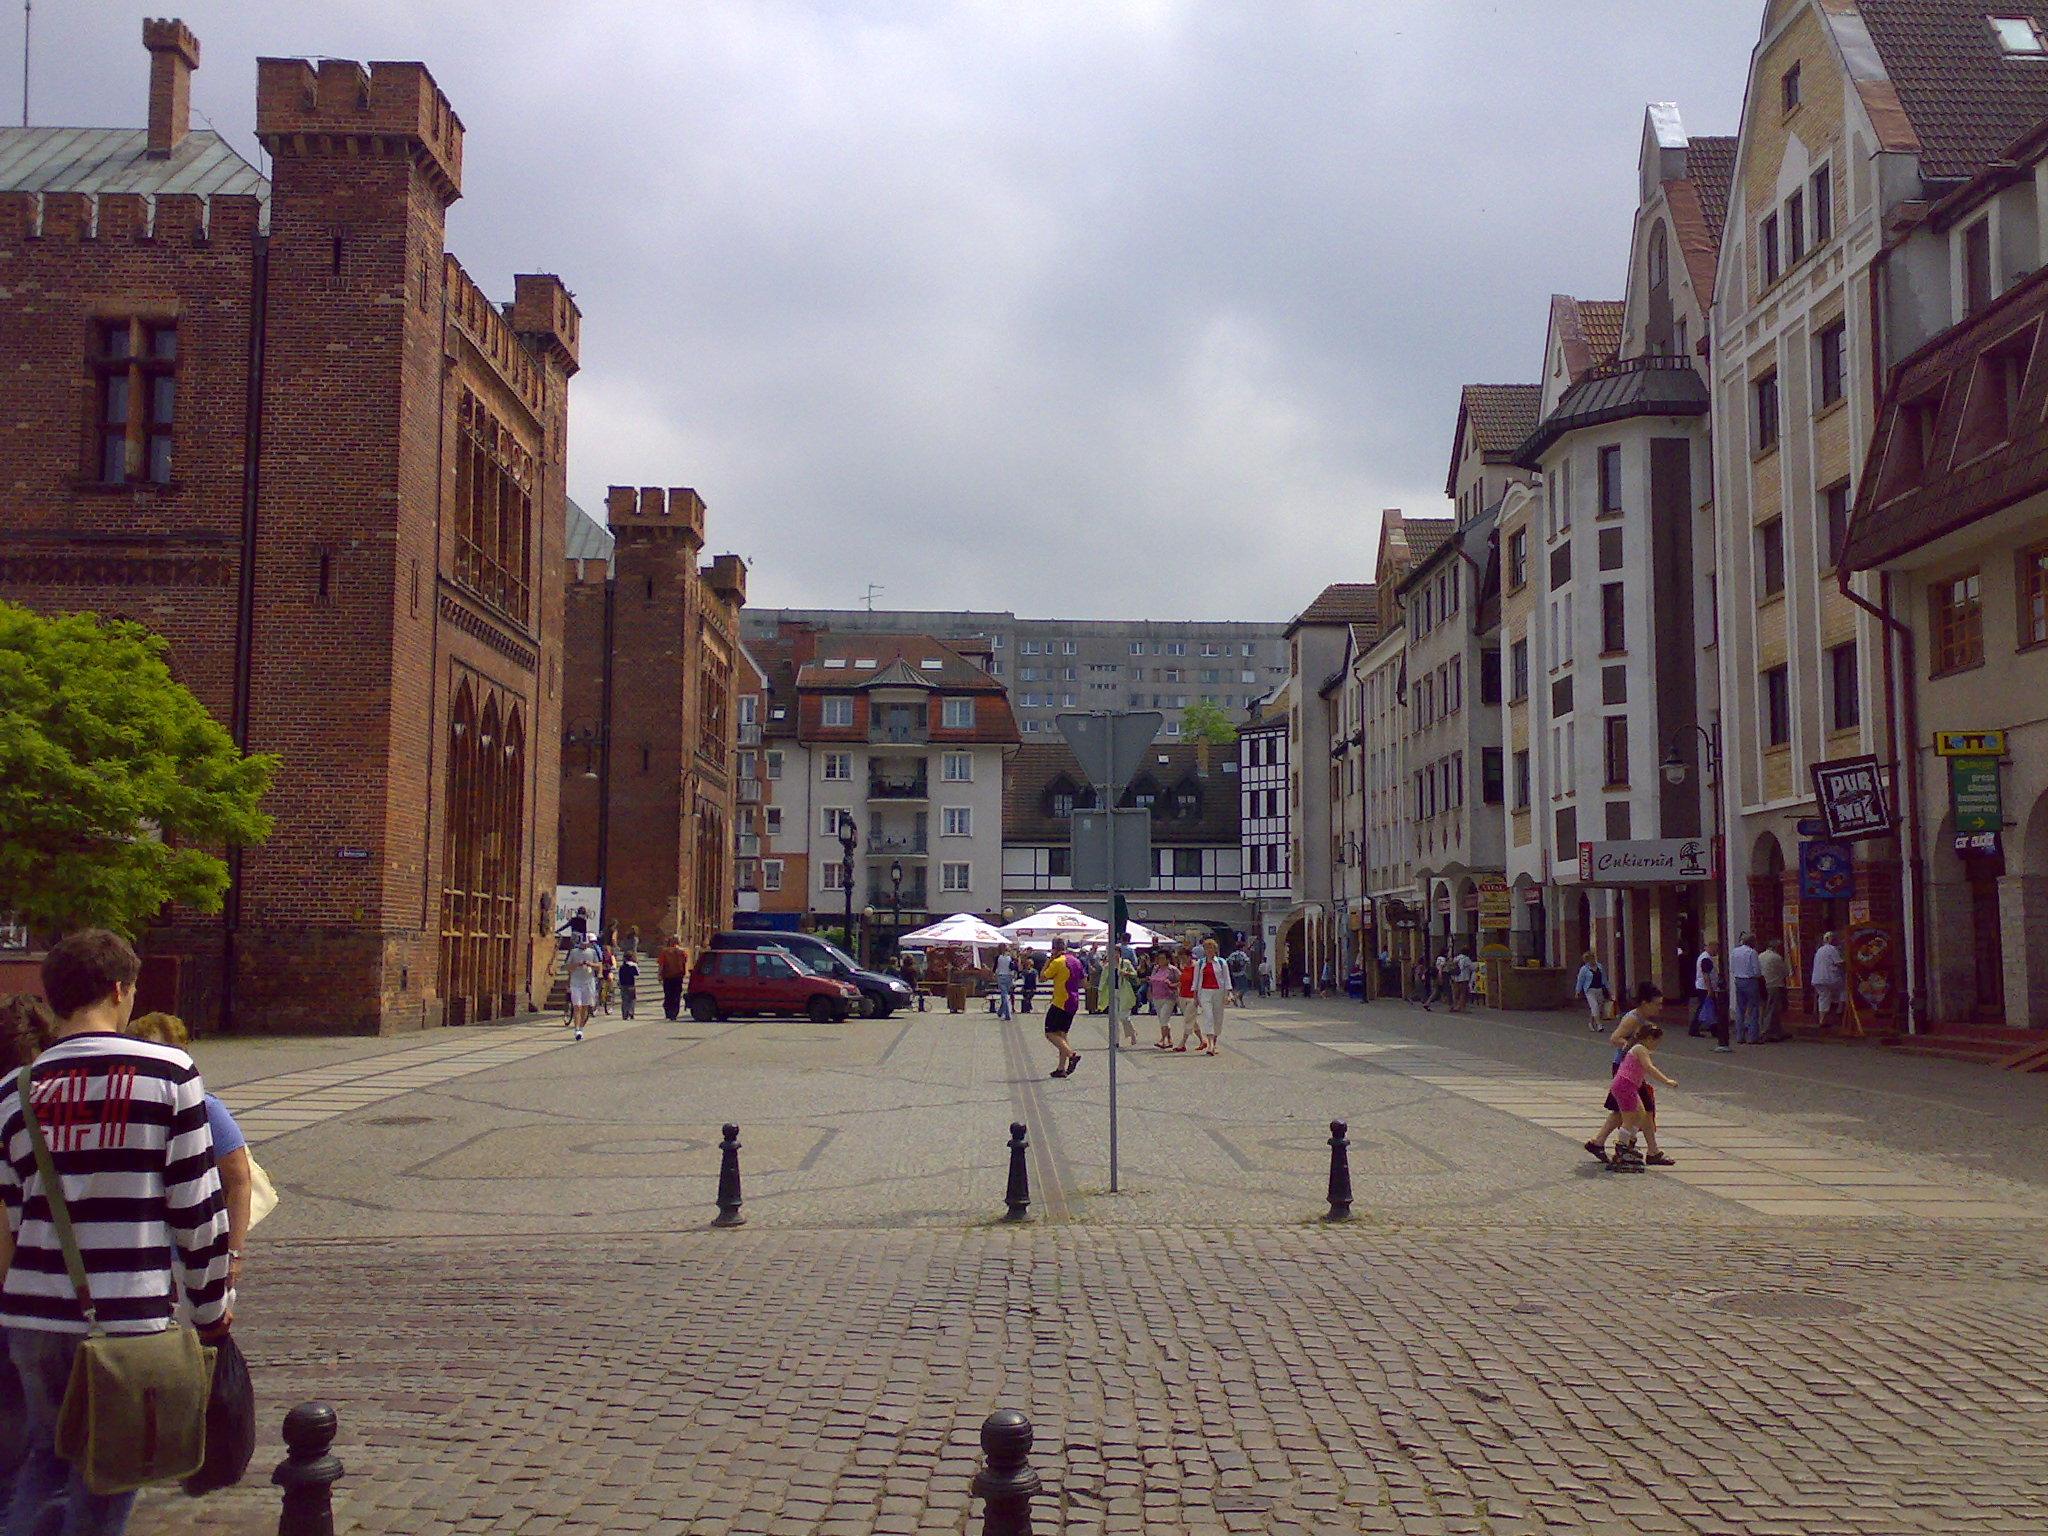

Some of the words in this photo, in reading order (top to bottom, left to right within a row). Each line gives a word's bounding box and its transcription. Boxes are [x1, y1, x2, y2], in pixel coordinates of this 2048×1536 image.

[1944, 735, 1997, 750] LOTTO
[1830, 771, 1872, 801] PUB
[1598, 852, 1675, 870] Cukiernia
